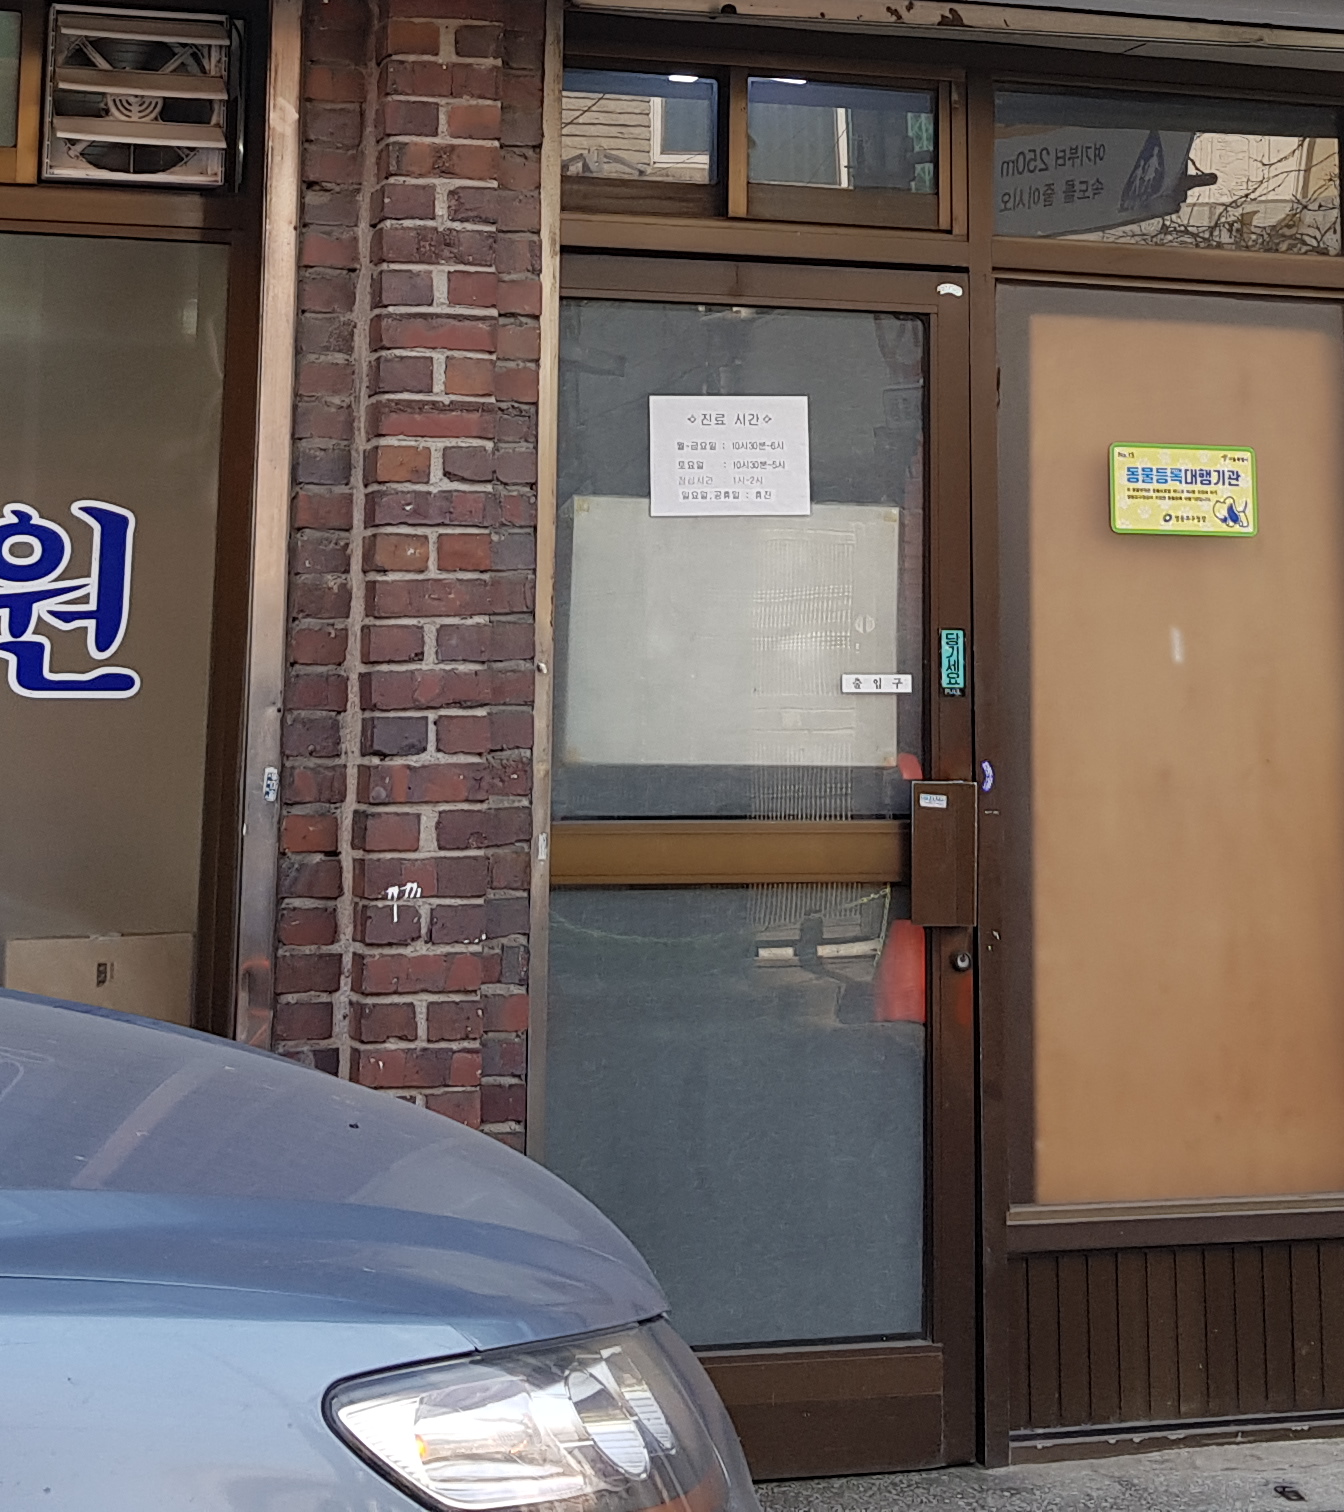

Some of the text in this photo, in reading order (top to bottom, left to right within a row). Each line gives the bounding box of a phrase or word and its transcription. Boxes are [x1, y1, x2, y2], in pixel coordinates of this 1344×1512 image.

[701, 413, 760, 426] 진료 시간
[945, 632, 961, 686] 당기세요
